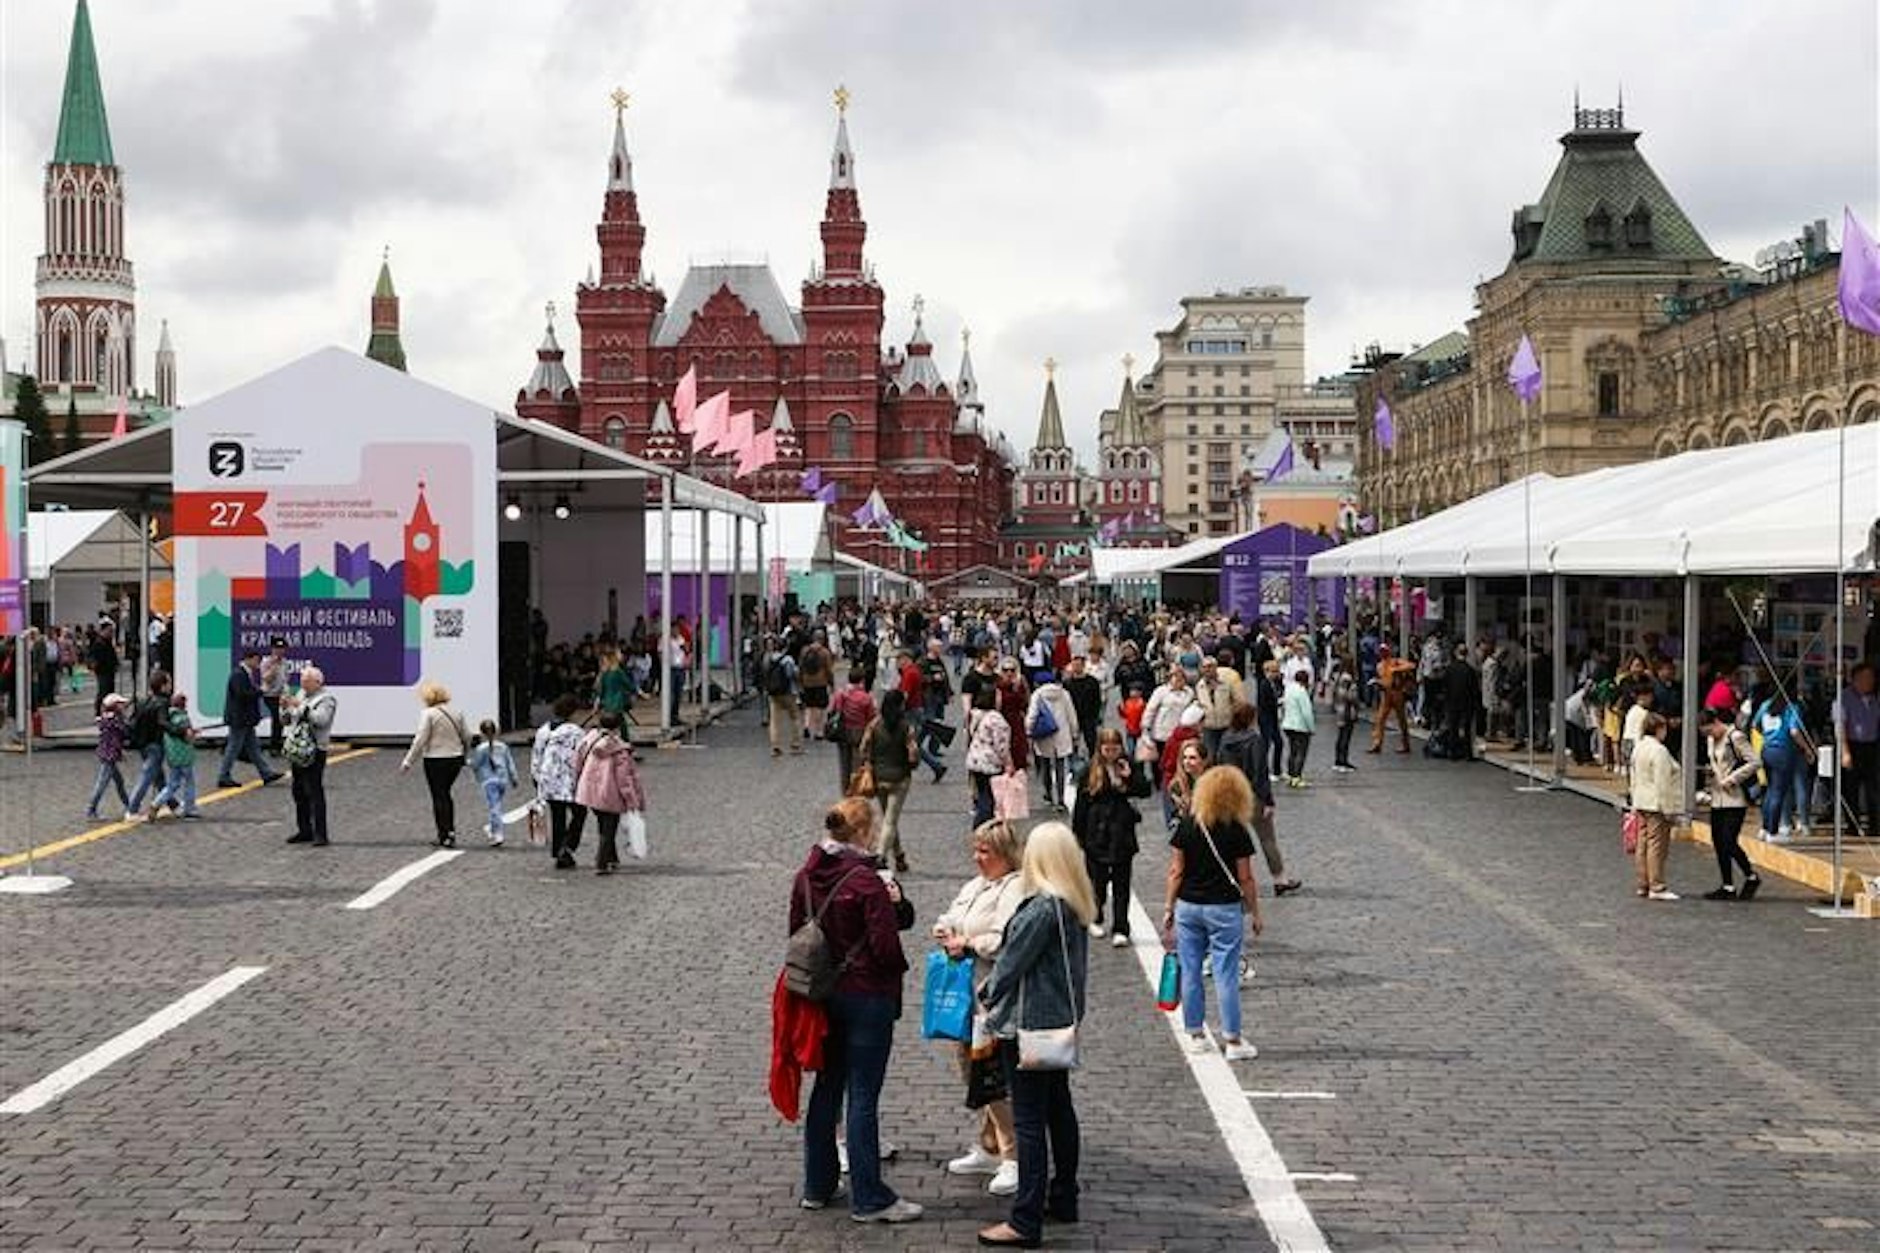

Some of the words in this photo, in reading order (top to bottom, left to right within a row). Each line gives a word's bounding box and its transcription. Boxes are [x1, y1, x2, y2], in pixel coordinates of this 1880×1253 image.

[209, 501, 245, 527] 27
[240, 607, 312, 627] КНИЖНЫЙ
[315, 608, 396, 627] ФЕСТИВАЛЬ
[240, 630, 302, 648] КРАСАЯ
[304, 630, 374, 648] ПЛОЩАДЬ
